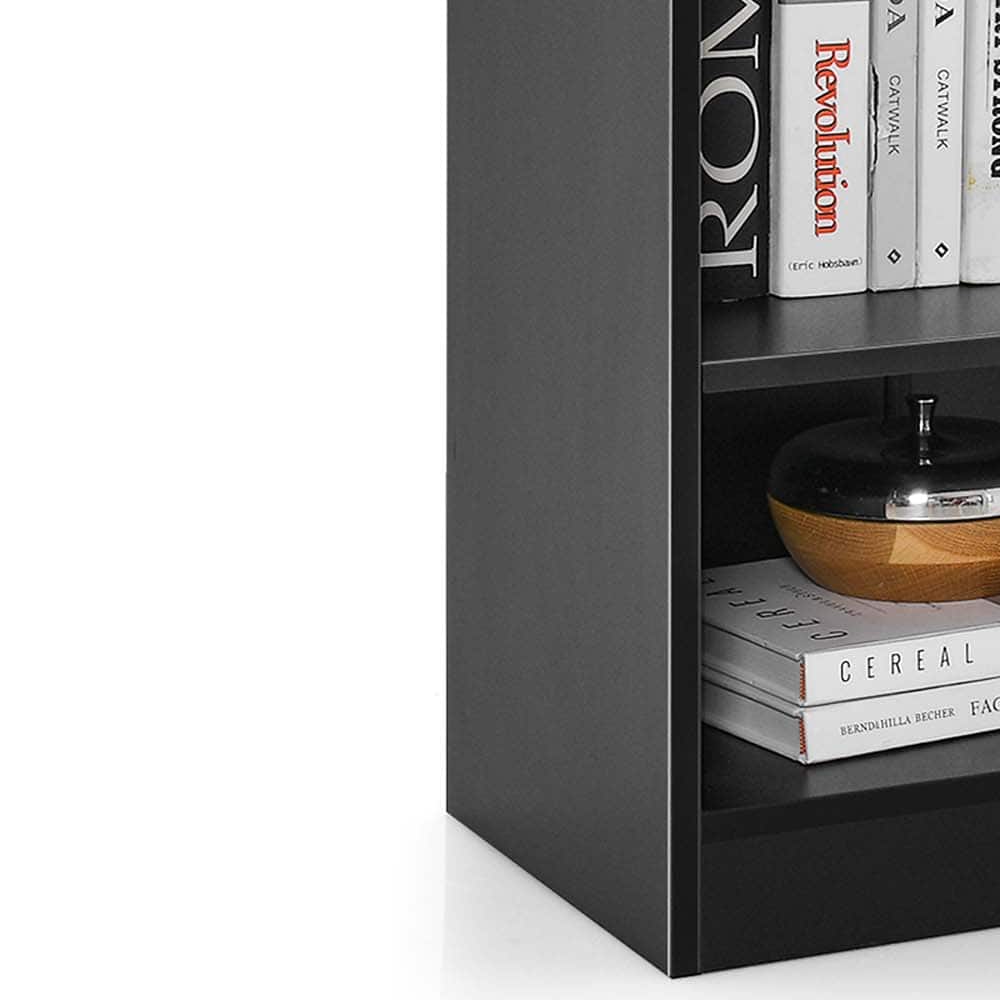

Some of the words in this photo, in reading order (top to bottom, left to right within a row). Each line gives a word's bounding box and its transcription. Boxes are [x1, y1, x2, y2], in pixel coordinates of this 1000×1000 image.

[815, 37, 851, 237] Revolution
[888, 75, 901, 156] CATWALK
[937, 69, 950, 151] CATWALK
[840, 644, 974, 682] CEREAL
[915, 708, 956, 722] BECHER
